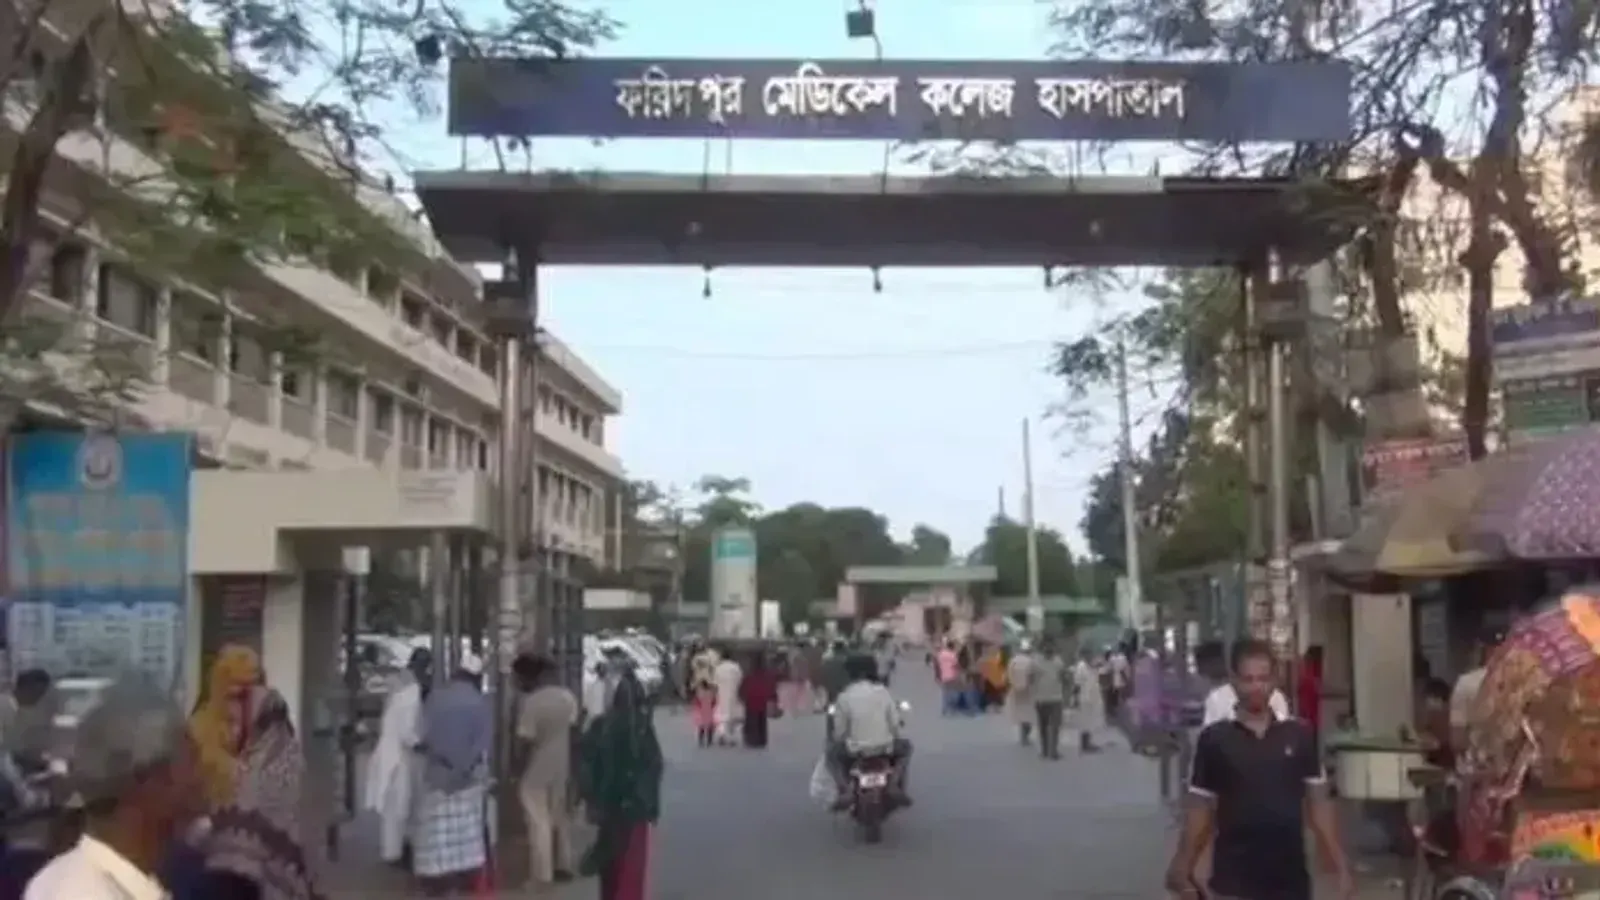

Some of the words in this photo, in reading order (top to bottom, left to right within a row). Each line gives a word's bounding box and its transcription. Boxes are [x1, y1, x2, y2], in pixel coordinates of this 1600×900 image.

[763, 62, 898, 116] মেডিকেল
[917, 77, 1016, 117] কলেজ
[1034, 76, 1185, 119] হাসপাতাল
